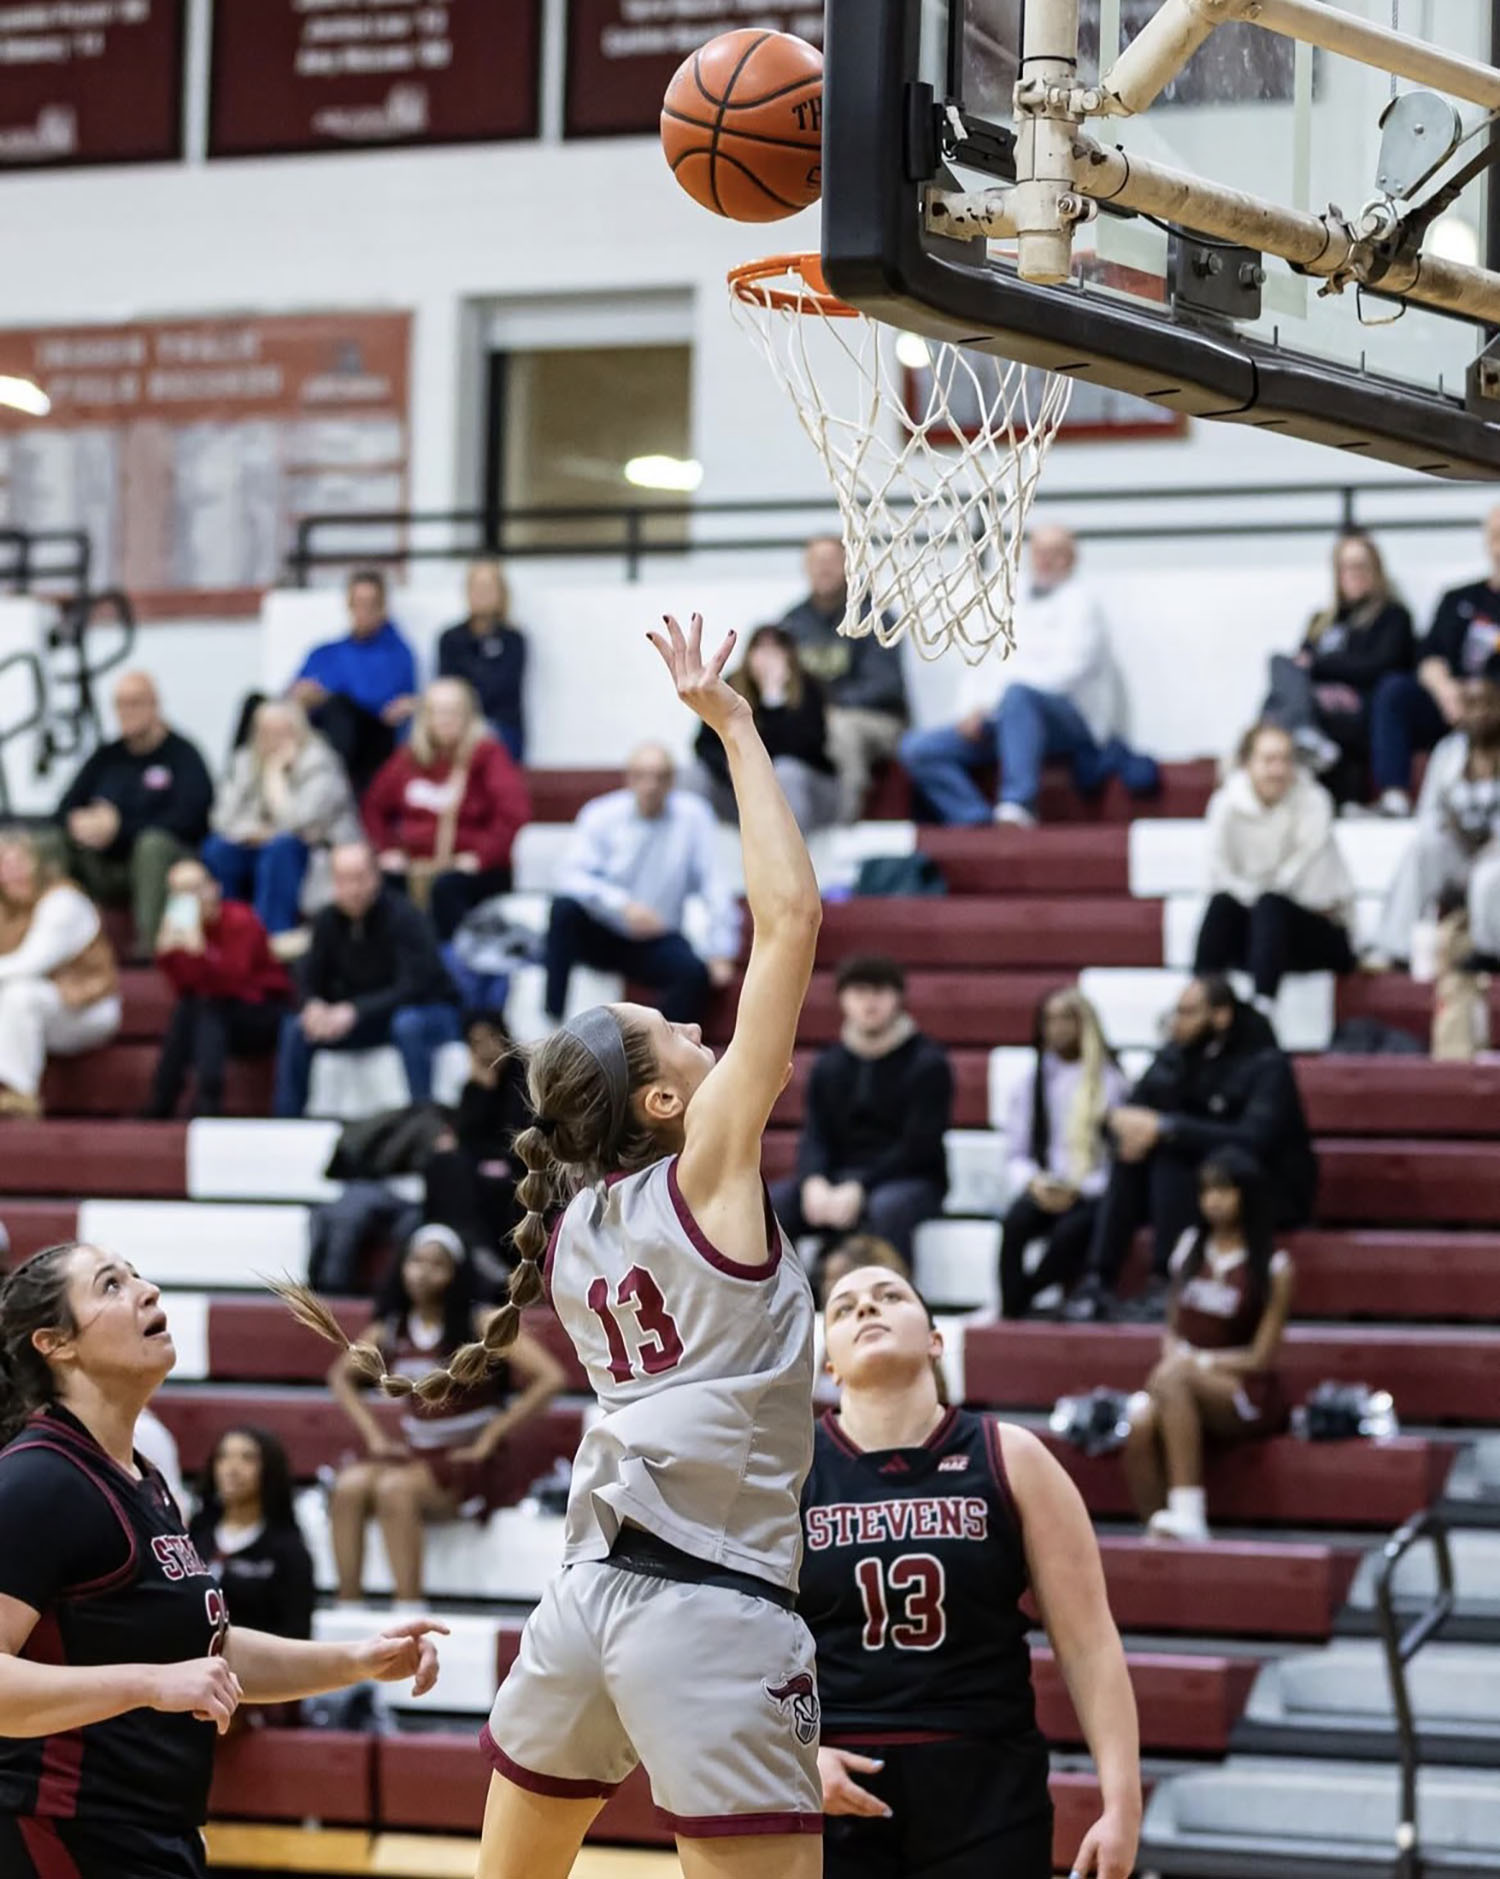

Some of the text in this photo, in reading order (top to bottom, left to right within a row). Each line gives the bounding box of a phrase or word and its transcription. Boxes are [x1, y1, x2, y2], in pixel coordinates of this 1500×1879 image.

[587, 1263, 685, 1386] 13
[806, 1497, 988, 1551] STEVENS
[855, 1553, 947, 1651] 13
